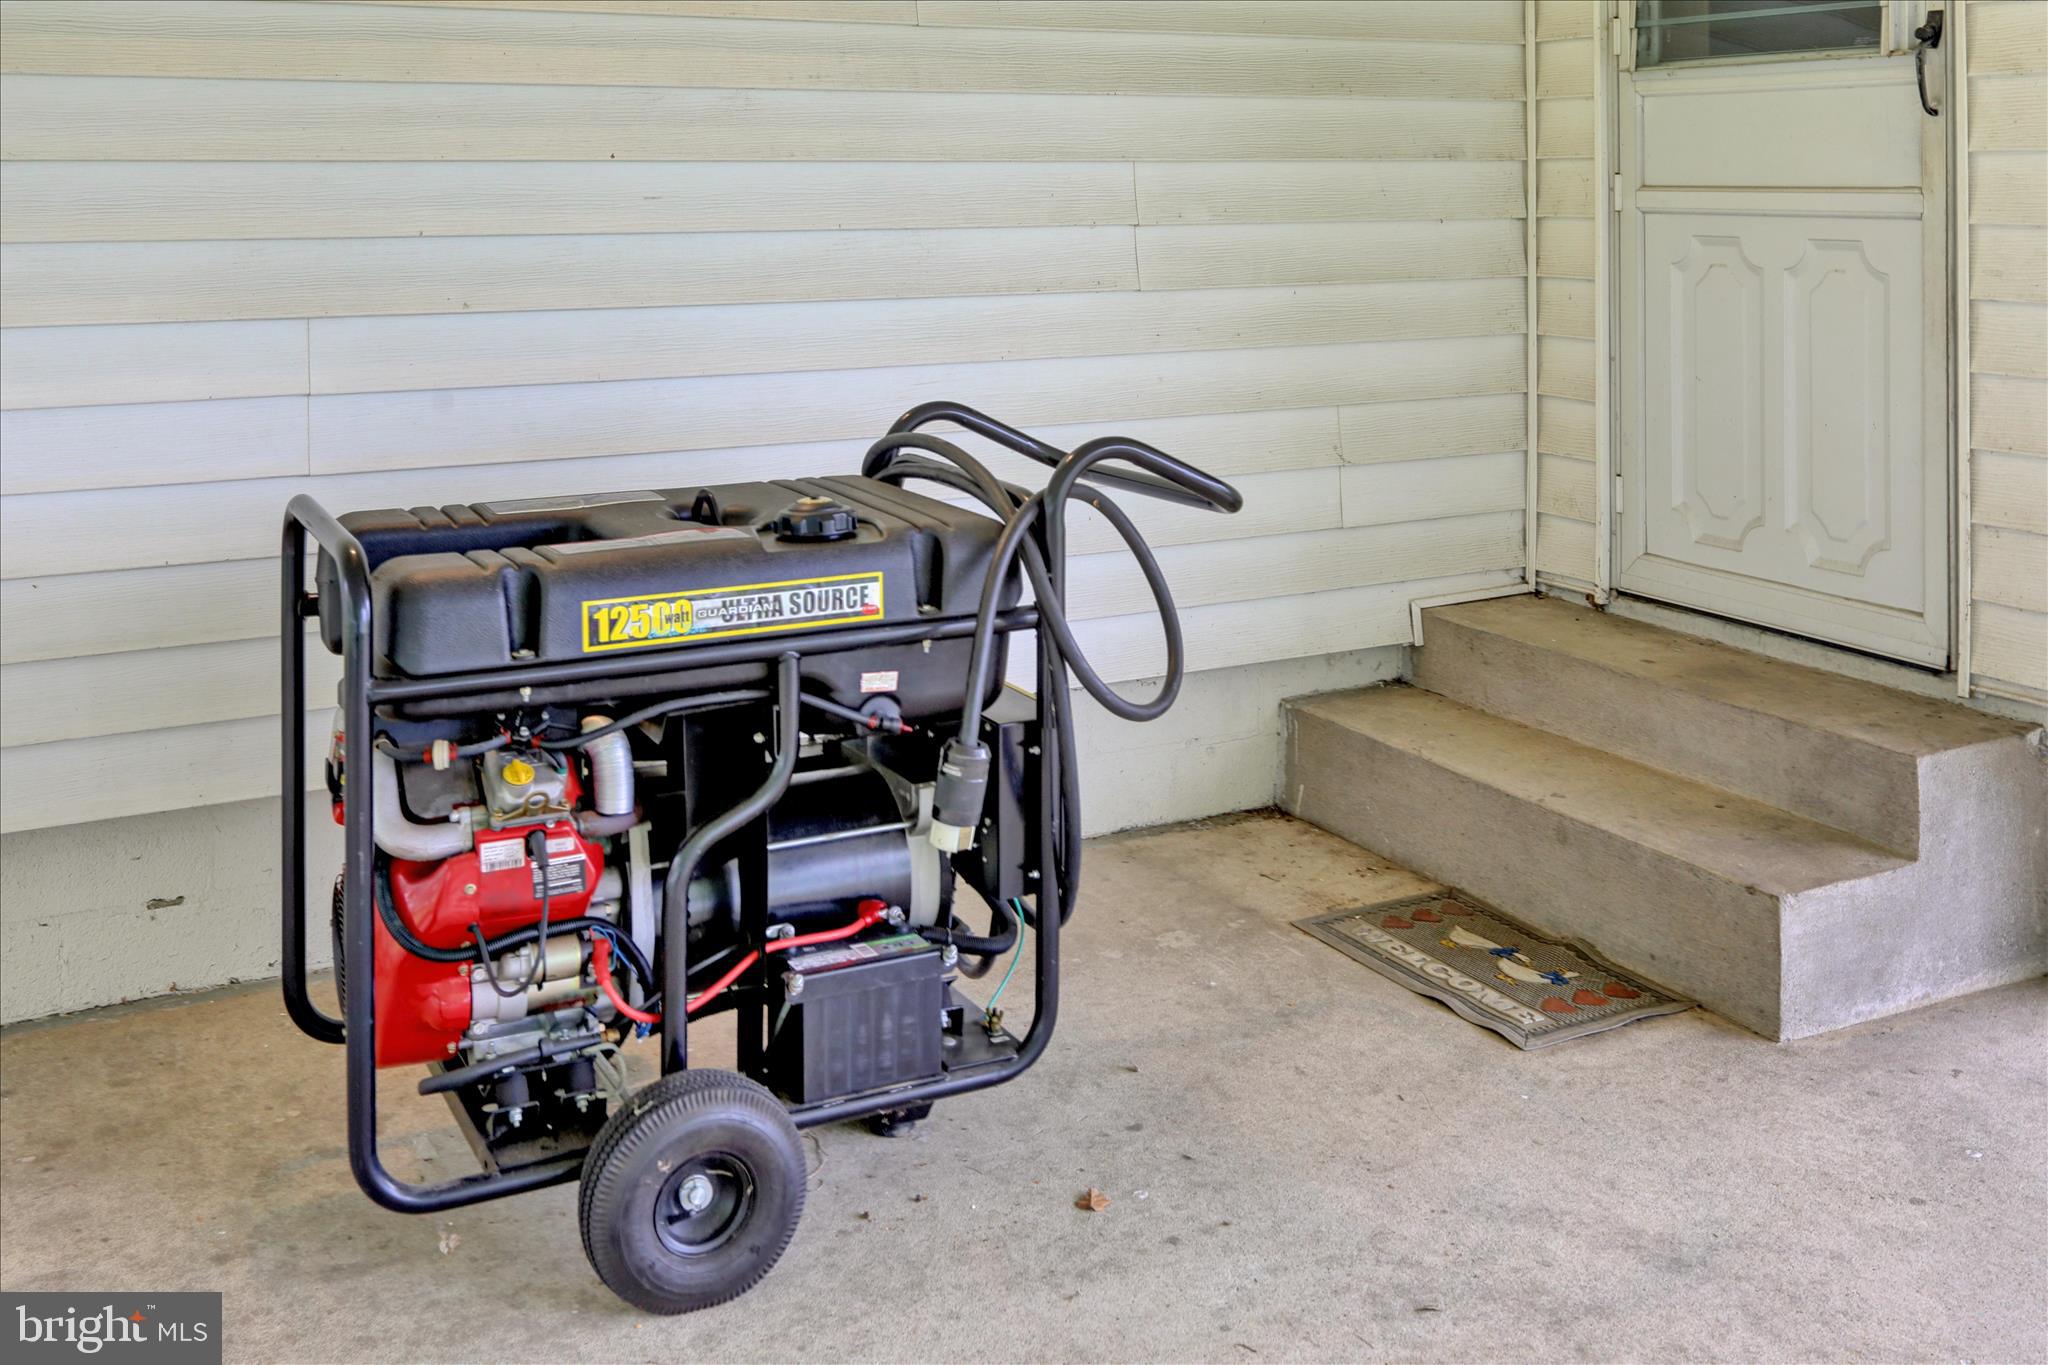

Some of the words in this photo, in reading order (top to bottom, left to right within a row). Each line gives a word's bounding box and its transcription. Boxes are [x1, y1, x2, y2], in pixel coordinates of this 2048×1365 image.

[697, 602, 776, 619] GUARDIAN
[789, 585, 869, 616] SOURCE
[593, 599, 692, 643] 12500
[664, 610, 690, 625] watt
[1353, 923, 1546, 1026] WELCOME
